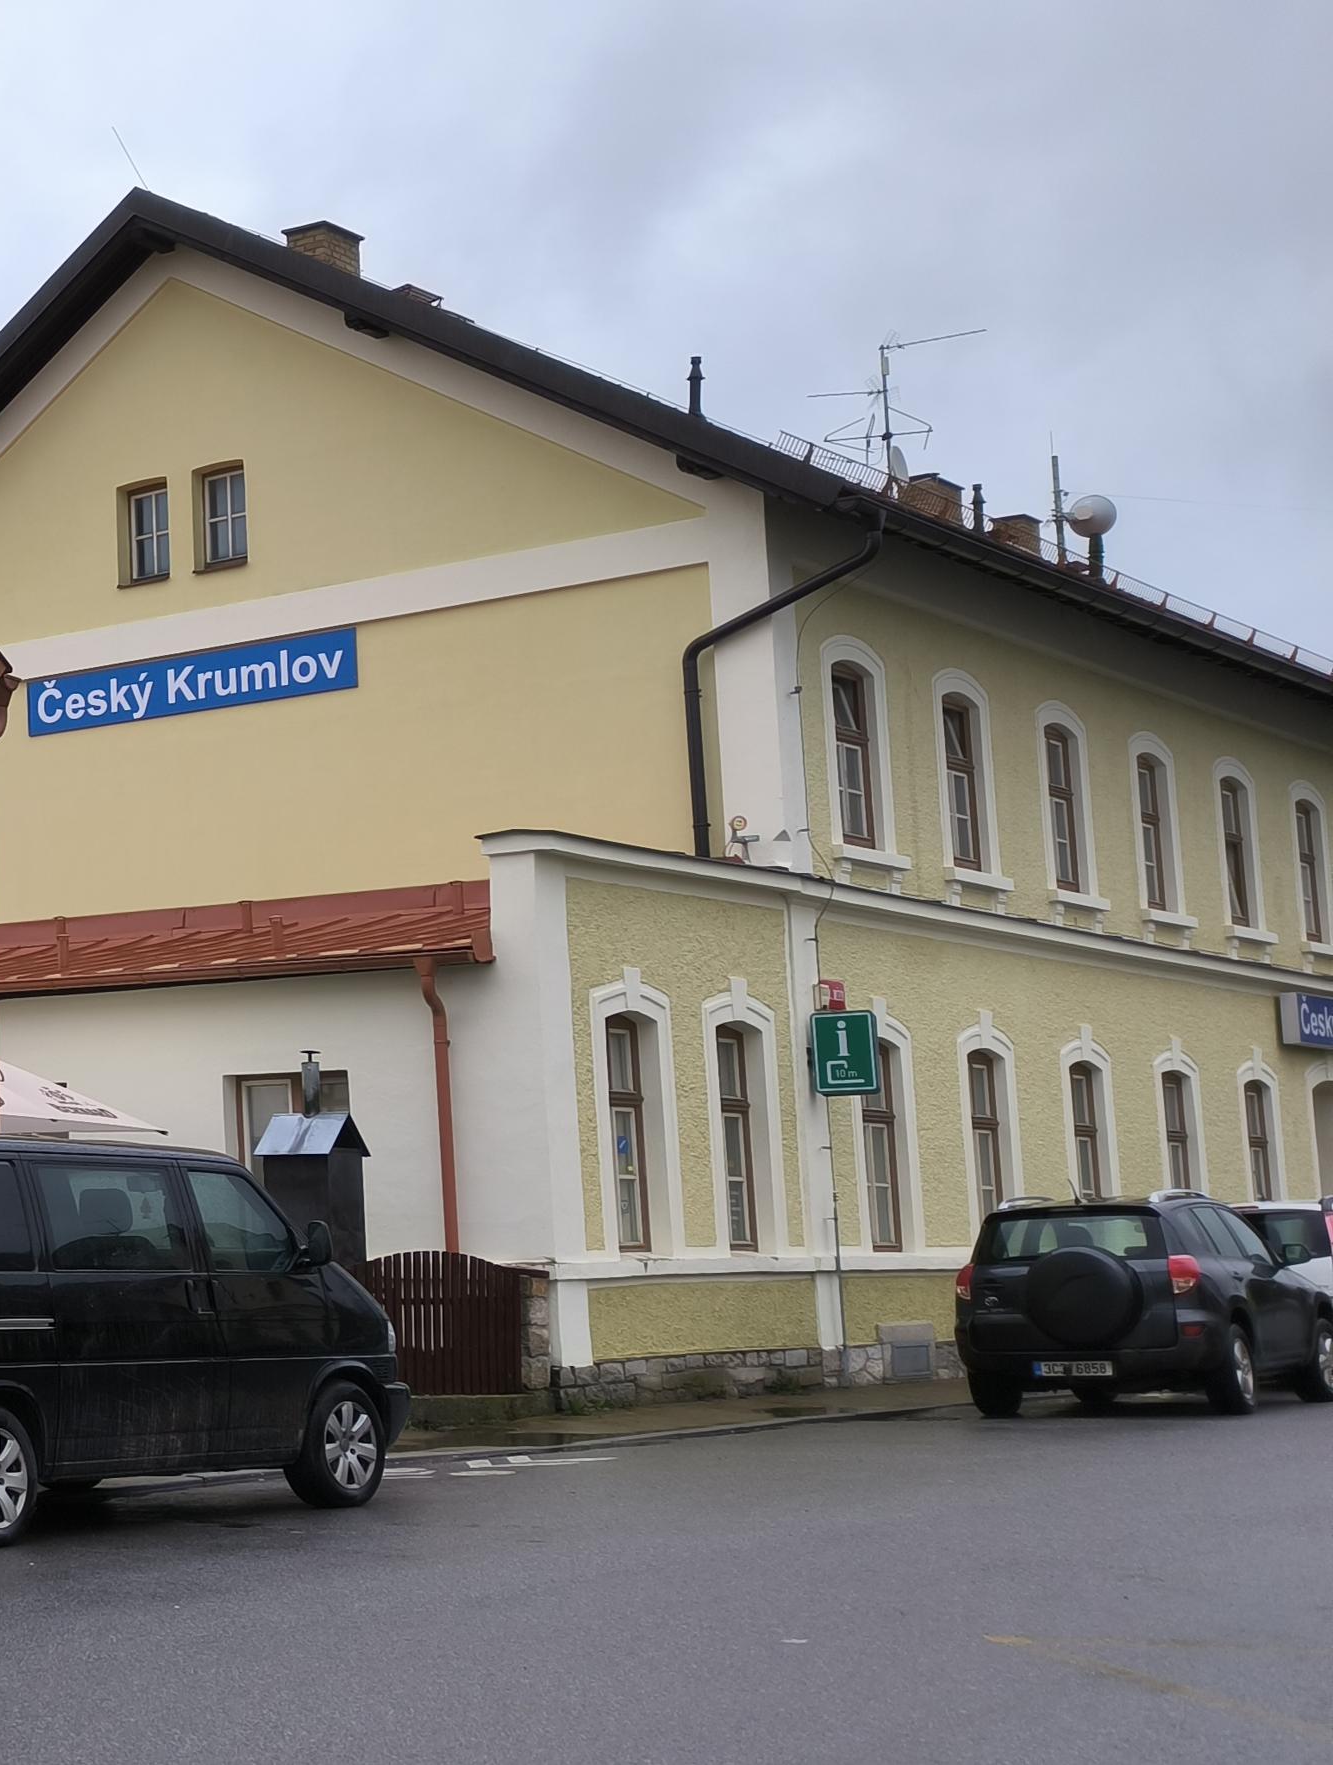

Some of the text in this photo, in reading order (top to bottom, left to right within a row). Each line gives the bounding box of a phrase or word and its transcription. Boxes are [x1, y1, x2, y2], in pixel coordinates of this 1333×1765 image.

[37, 650, 343, 723] Český Krumlov
[835, 1069, 846, 1078] 10
